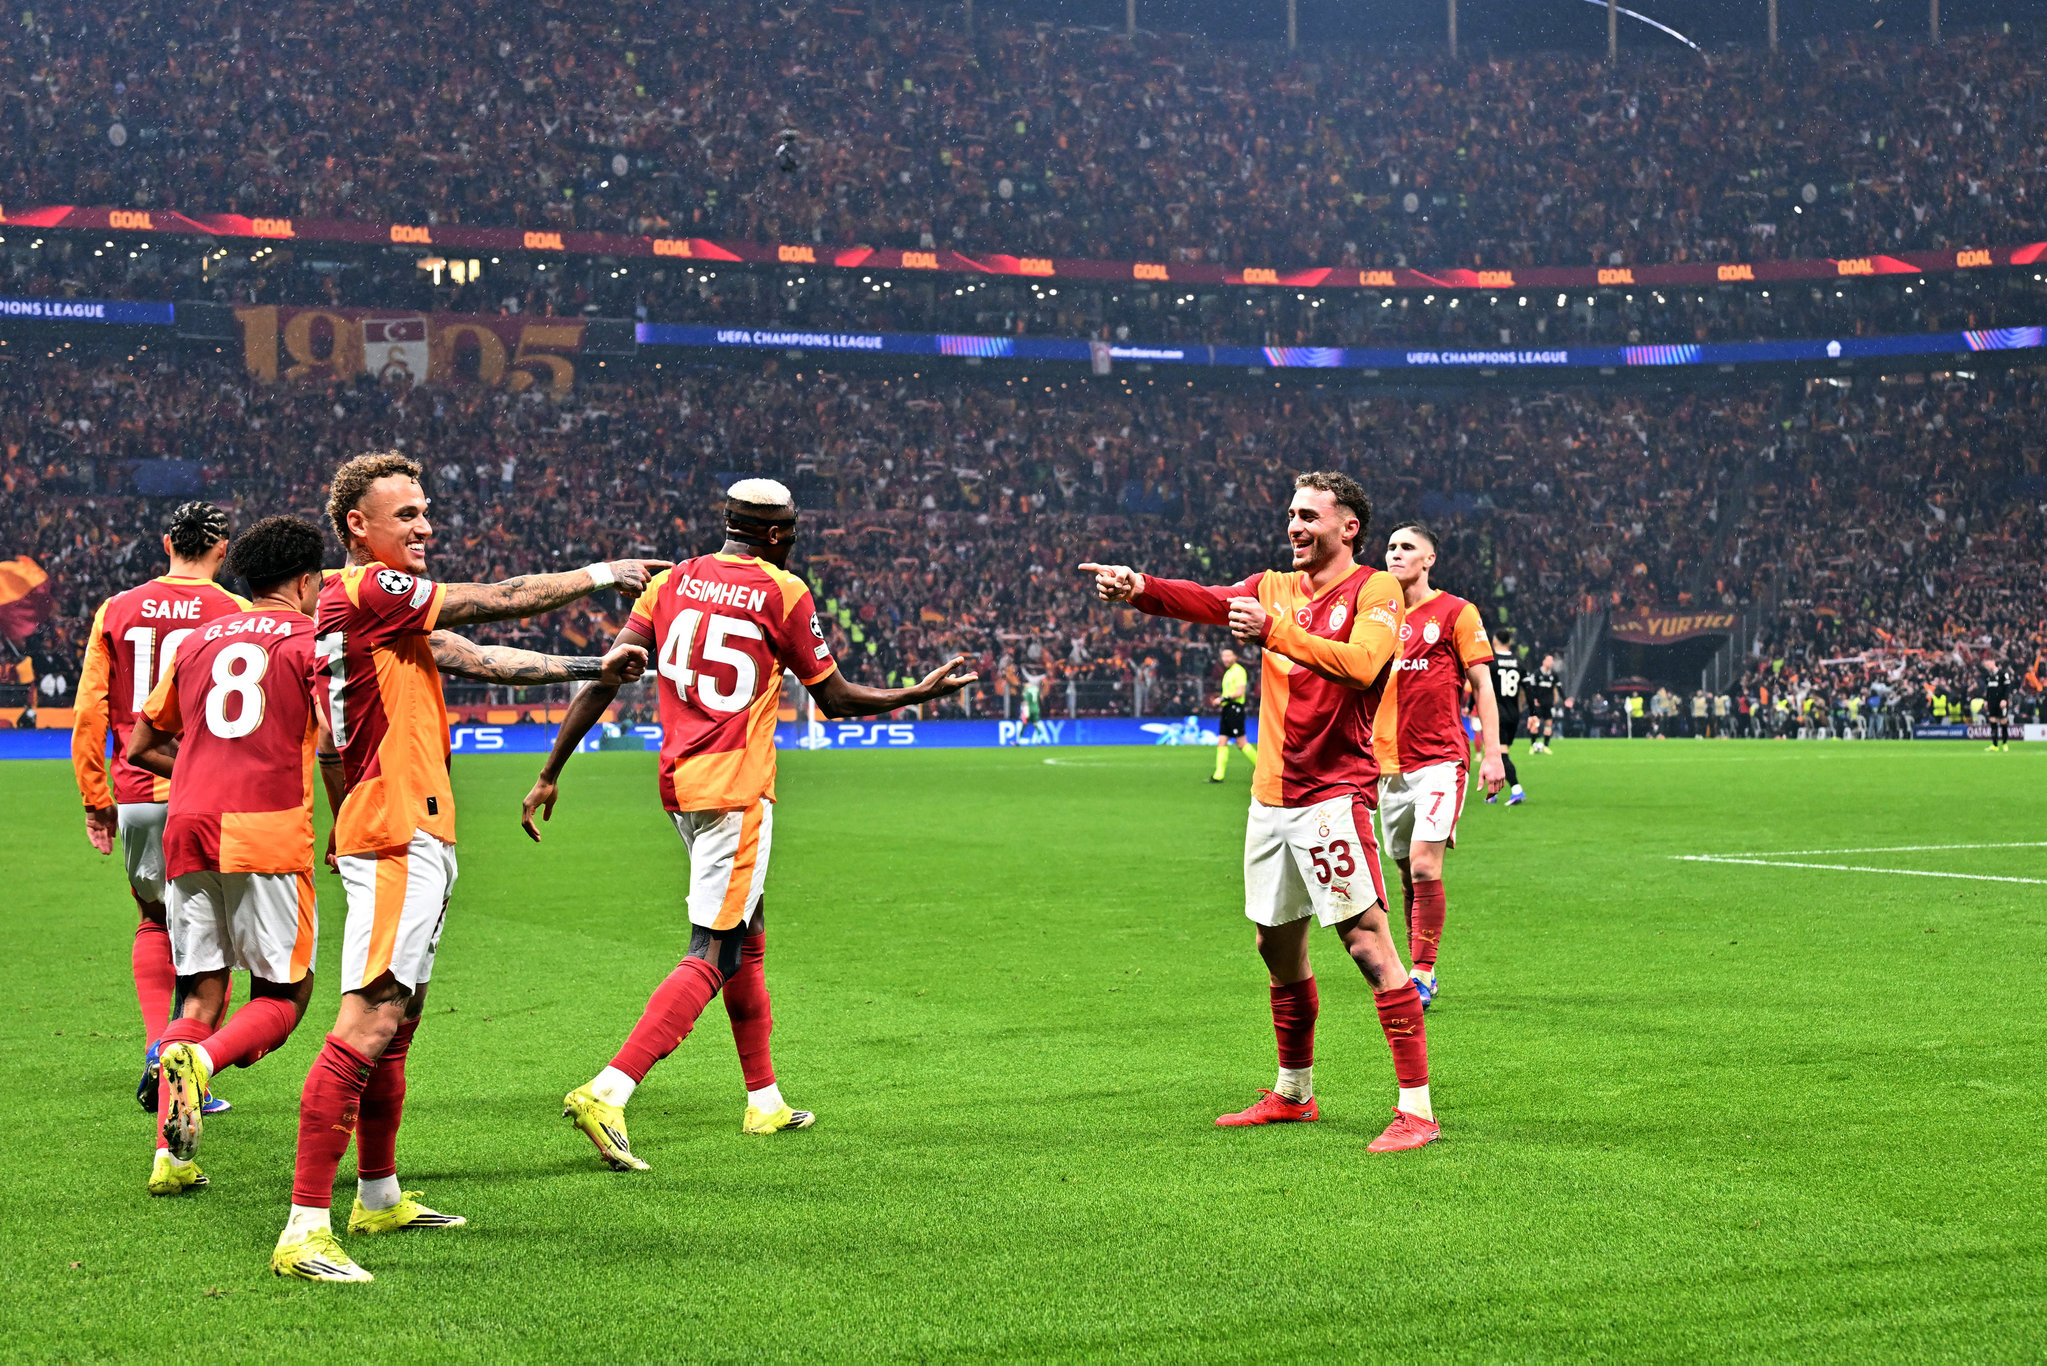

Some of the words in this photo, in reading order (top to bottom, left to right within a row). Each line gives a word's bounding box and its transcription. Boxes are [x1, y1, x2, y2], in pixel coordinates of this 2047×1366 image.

[110, 211, 153, 229] GOAL
[253, 218, 295, 236] GOAL
[390, 225, 433, 244] GOAL
[525, 231, 565, 250] GOAL
[653, 239, 692, 257] GOAL
[778, 245, 816, 263] GOAL
[902, 251, 939, 269] GOAL
[1020, 258, 1055, 275] GOAL
[1838, 258, 1873, 275] GOAL
[1956, 250, 1992, 268] GOAL
[1133, 263, 1169, 280] GOAL
[1243, 268, 1279, 284] GOAL
[1478, 270, 1516, 286] GOAL
[1598, 268, 1635, 284] GOAL
[1718, 264, 1755, 281] GOAL
[45, 303, 105, 318] LEAGUE
[717, 330, 751, 343] UEFA
[753, 331, 831, 347] CHAMPIONS
[833, 335, 882, 349] LEAGUE
[1407, 352, 1440, 365] UEFA
[1441, 351, 1516, 365] CHAMPIONS
[1519, 350, 1568, 363] LEAGUE
[676, 574, 768, 612] OSIMHEN
[141, 597, 203, 620] SANÉ
[204, 616, 293, 642] G.SARA
[658, 608, 765, 712] 45
[1391, 658, 1429, 671] OCAR
[205, 641, 269, 739] 8
[1497, 668, 1520, 697] 18
[450, 728, 505, 749] S5
[838, 724, 914, 745] PS5
[999, 720, 1065, 745] PLAY
[1428, 791, 1445, 815] 7
[1309, 839, 1356, 885] 53
